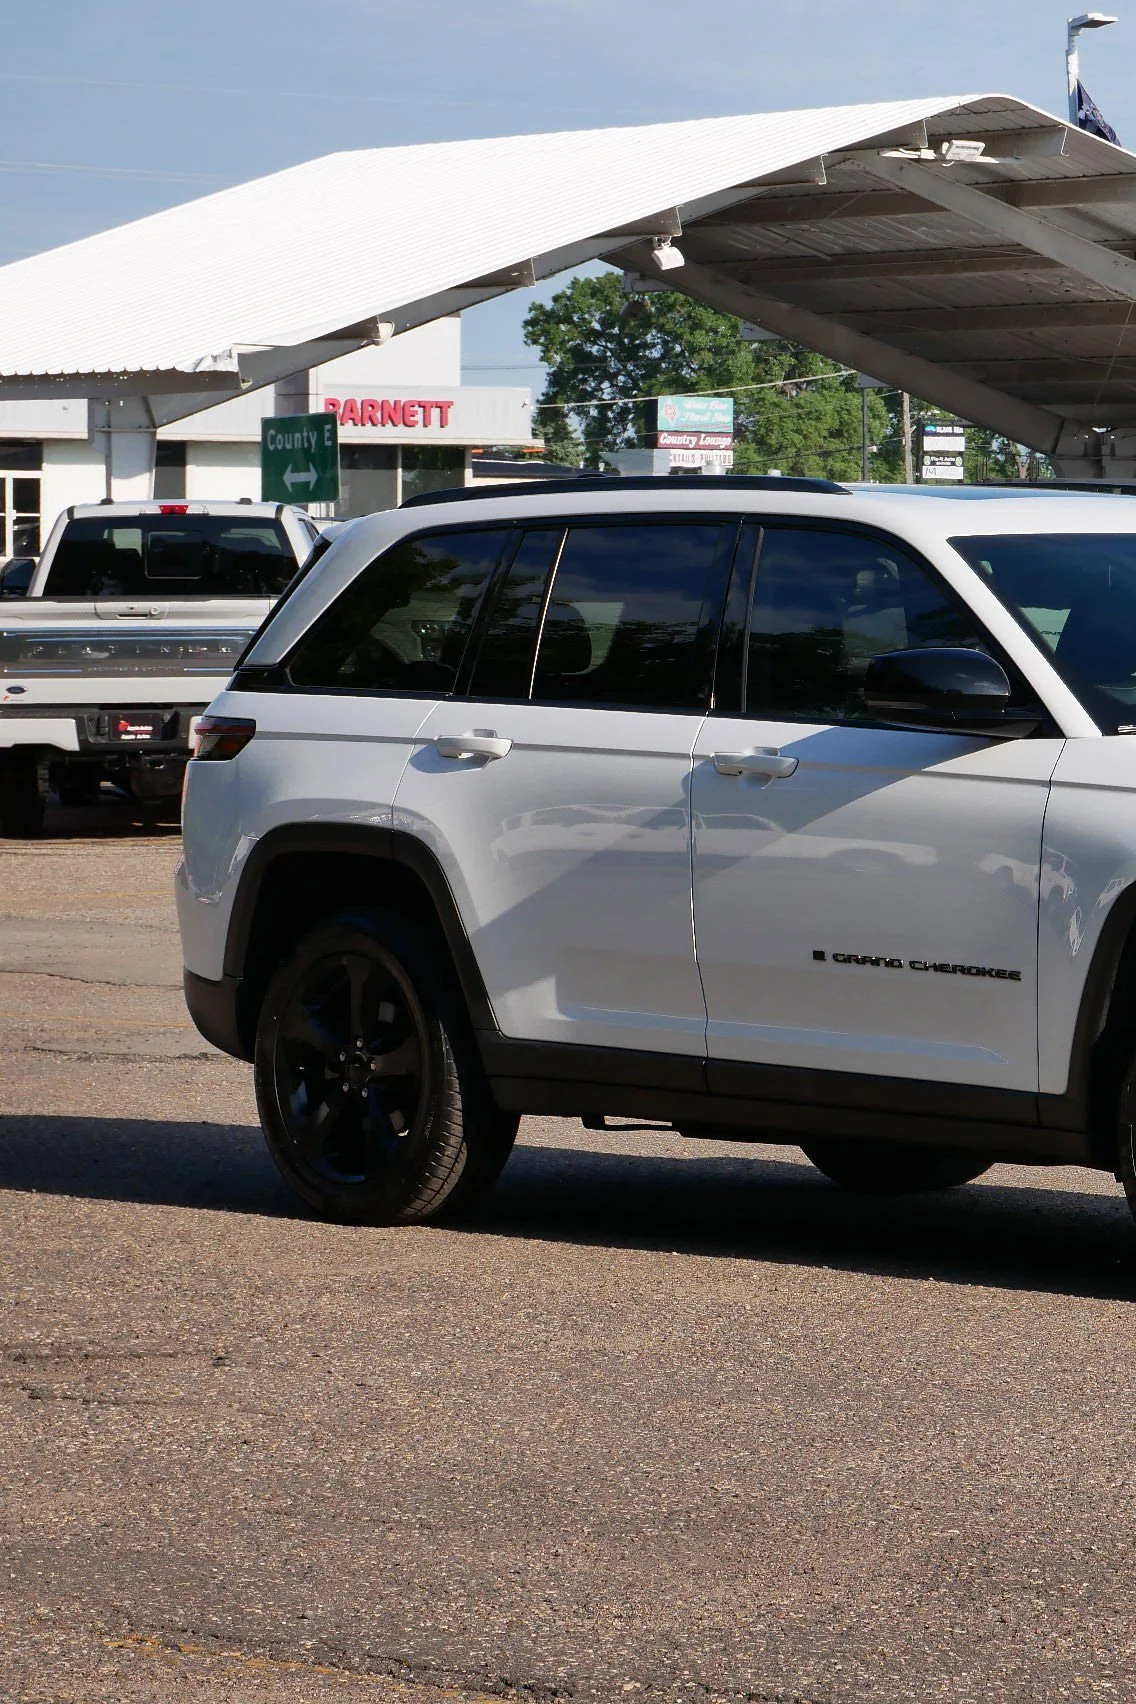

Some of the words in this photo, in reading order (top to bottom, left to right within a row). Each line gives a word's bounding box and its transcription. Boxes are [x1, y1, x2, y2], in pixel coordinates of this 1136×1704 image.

[324, 397, 454, 428] BARNETT
[267, 427, 317, 453] County
[323, 424, 333, 447] E
[659, 432, 698, 448] Country
[699, 433, 732, 449] Lounge
[832, 952, 904, 968] GRAND
[908, 960, 1022, 982] CHEROKEE
